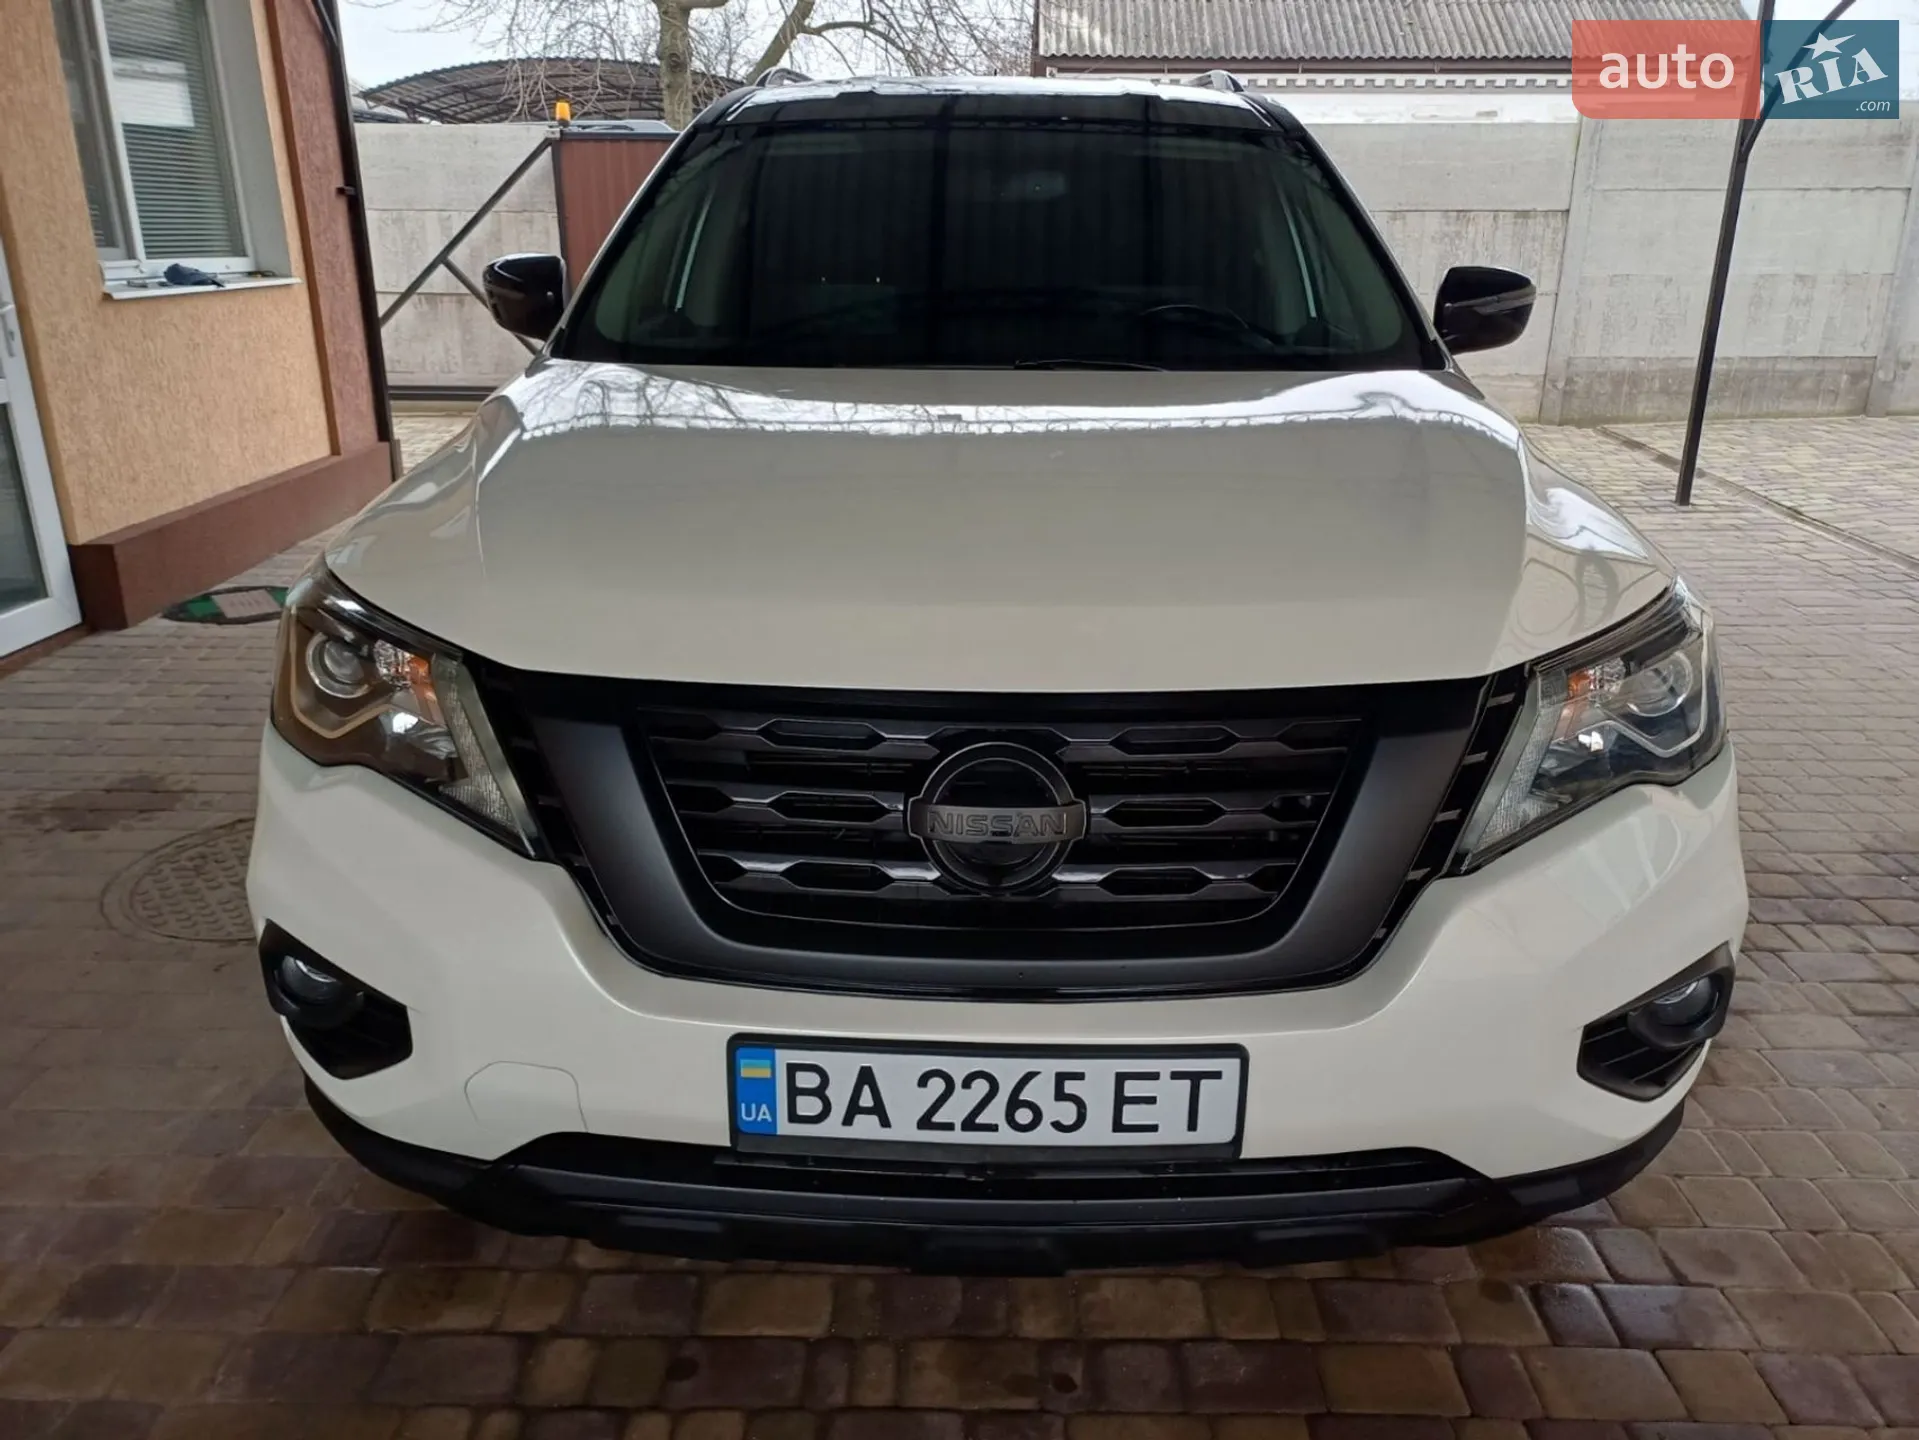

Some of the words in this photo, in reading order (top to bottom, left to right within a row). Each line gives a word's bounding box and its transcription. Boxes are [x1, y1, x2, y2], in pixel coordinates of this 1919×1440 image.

[927, 811, 1067, 838] NISSAN
[785, 1061, 892, 1129] BA
[916, 1068, 1088, 1134] 2265
[1111, 1070, 1223, 1133] ET
[740, 1102, 772, 1123] UA
